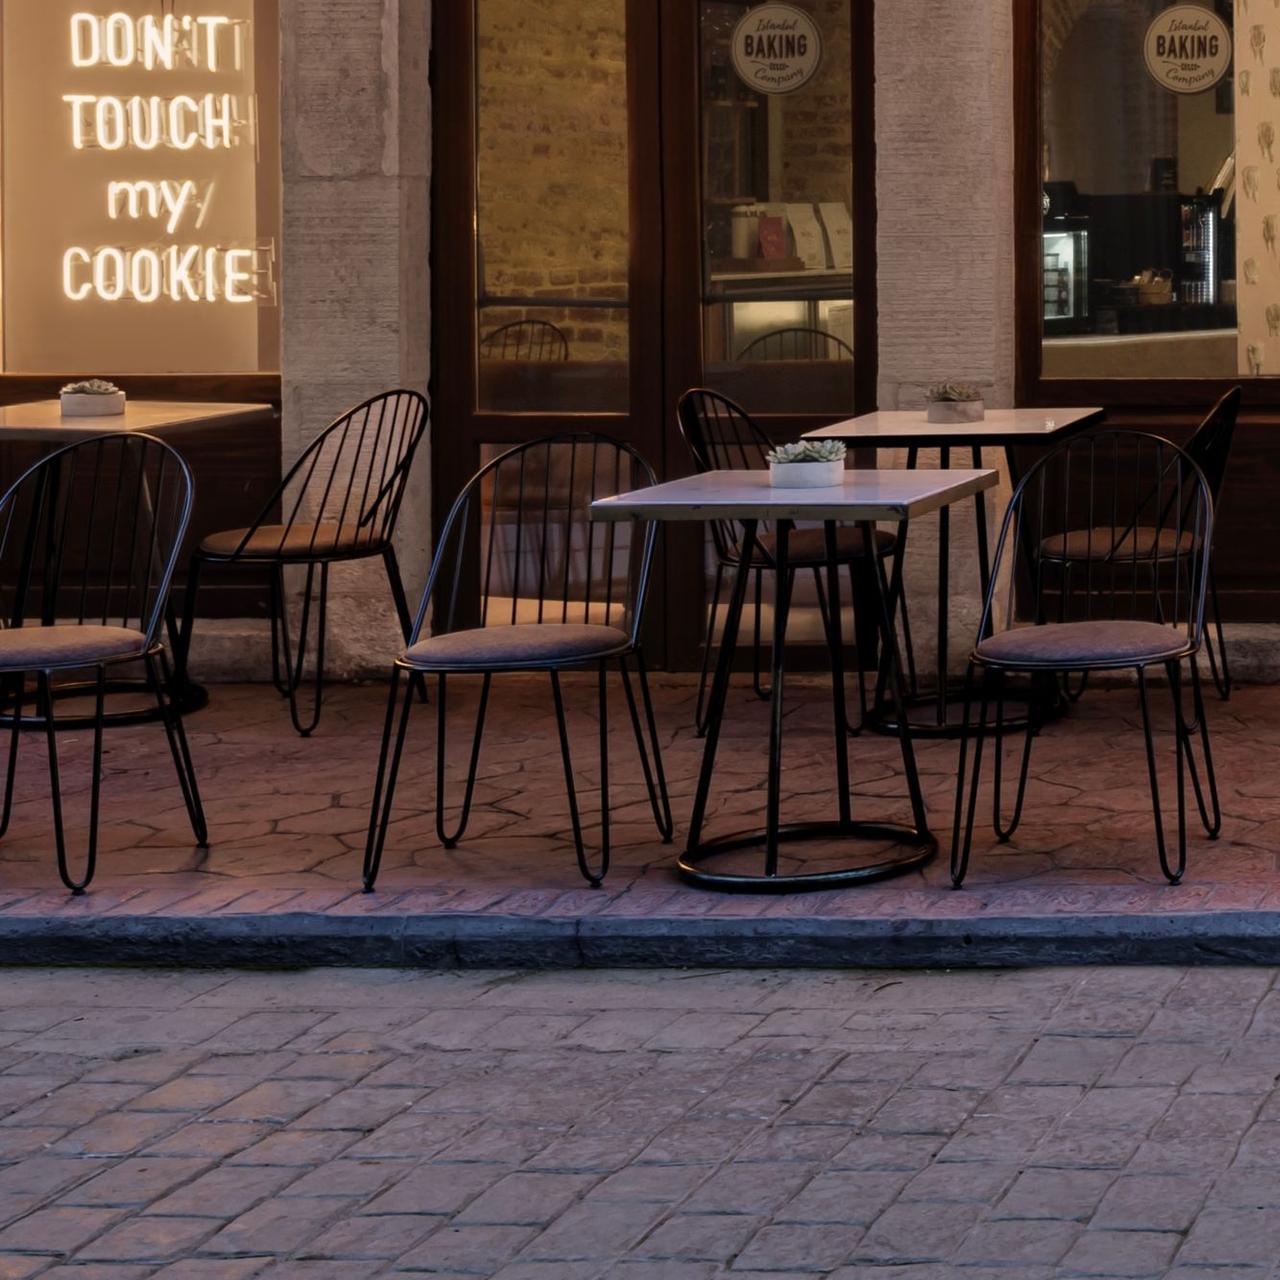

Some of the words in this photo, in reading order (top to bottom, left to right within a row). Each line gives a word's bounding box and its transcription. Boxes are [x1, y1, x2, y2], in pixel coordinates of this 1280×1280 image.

[756, 19, 798, 32] Istanbul
[1168, 19, 1210, 32] Istanbul
[70, 12, 229, 72] DON'T
[744, 34, 807, 59] BAKING
[1156, 35, 1219, 60] BAKING
[754, 68, 803, 86] Company
[1166, 68, 1215, 86] Company
[62, 93, 231, 150] TOUCH
[107, 178, 194, 234] my
[62, 245, 255, 303] COOKIE
